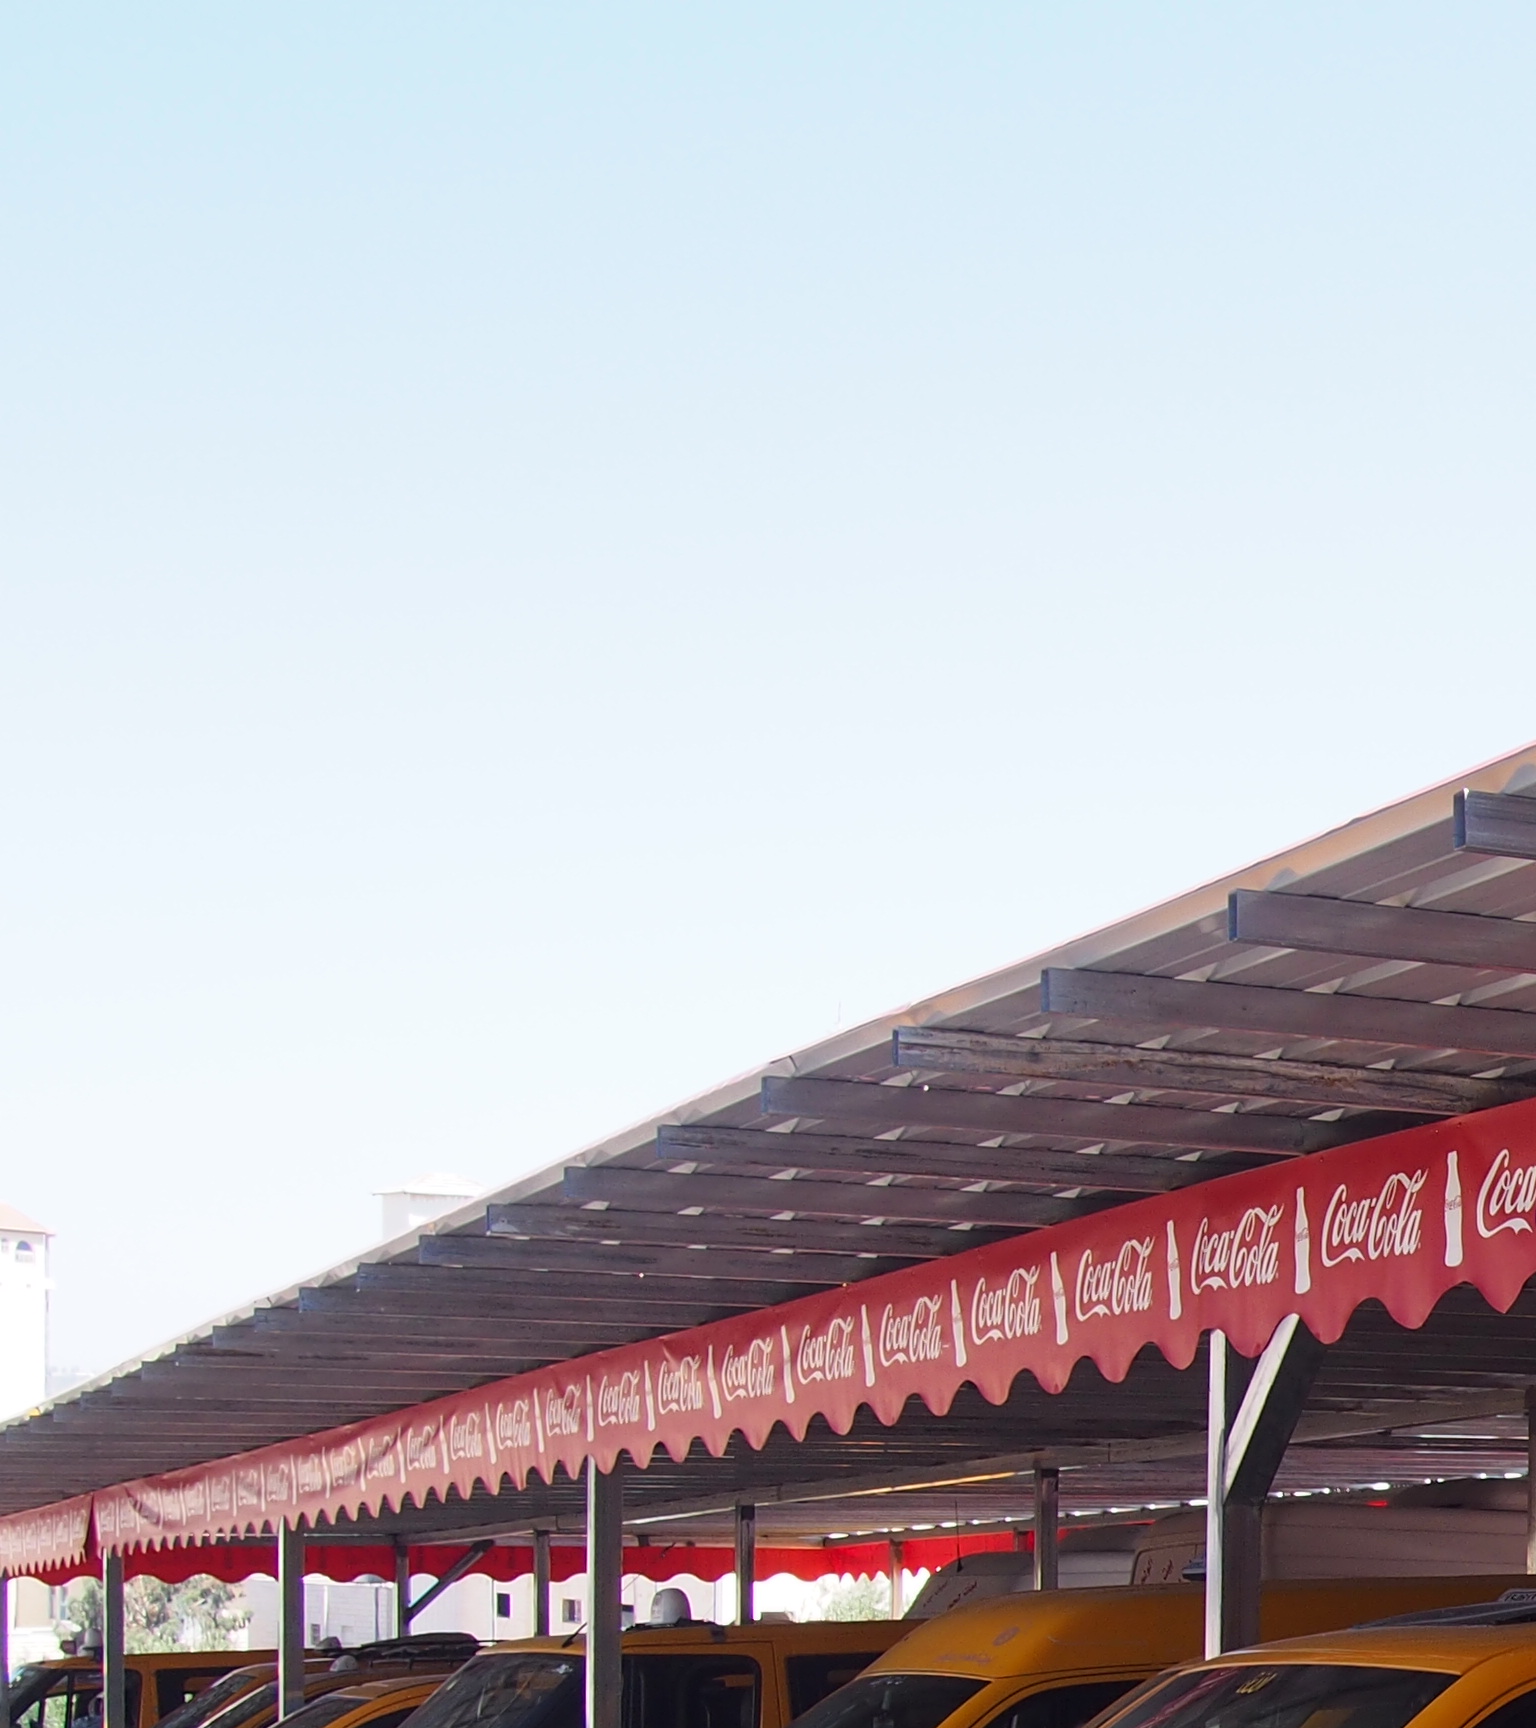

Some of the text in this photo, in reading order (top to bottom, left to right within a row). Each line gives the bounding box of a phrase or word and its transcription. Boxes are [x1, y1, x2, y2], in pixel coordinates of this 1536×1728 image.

[1191, 1204, 1284, 1295] Coca-Cola
[1320, 1169, 1428, 1268] Coca-Cola
[970, 1265, 1043, 1347] Coca-Cola
[1075, 1236, 1155, 1323] Coca-Cola
[879, 1296, 944, 1368] Coca-Cola
